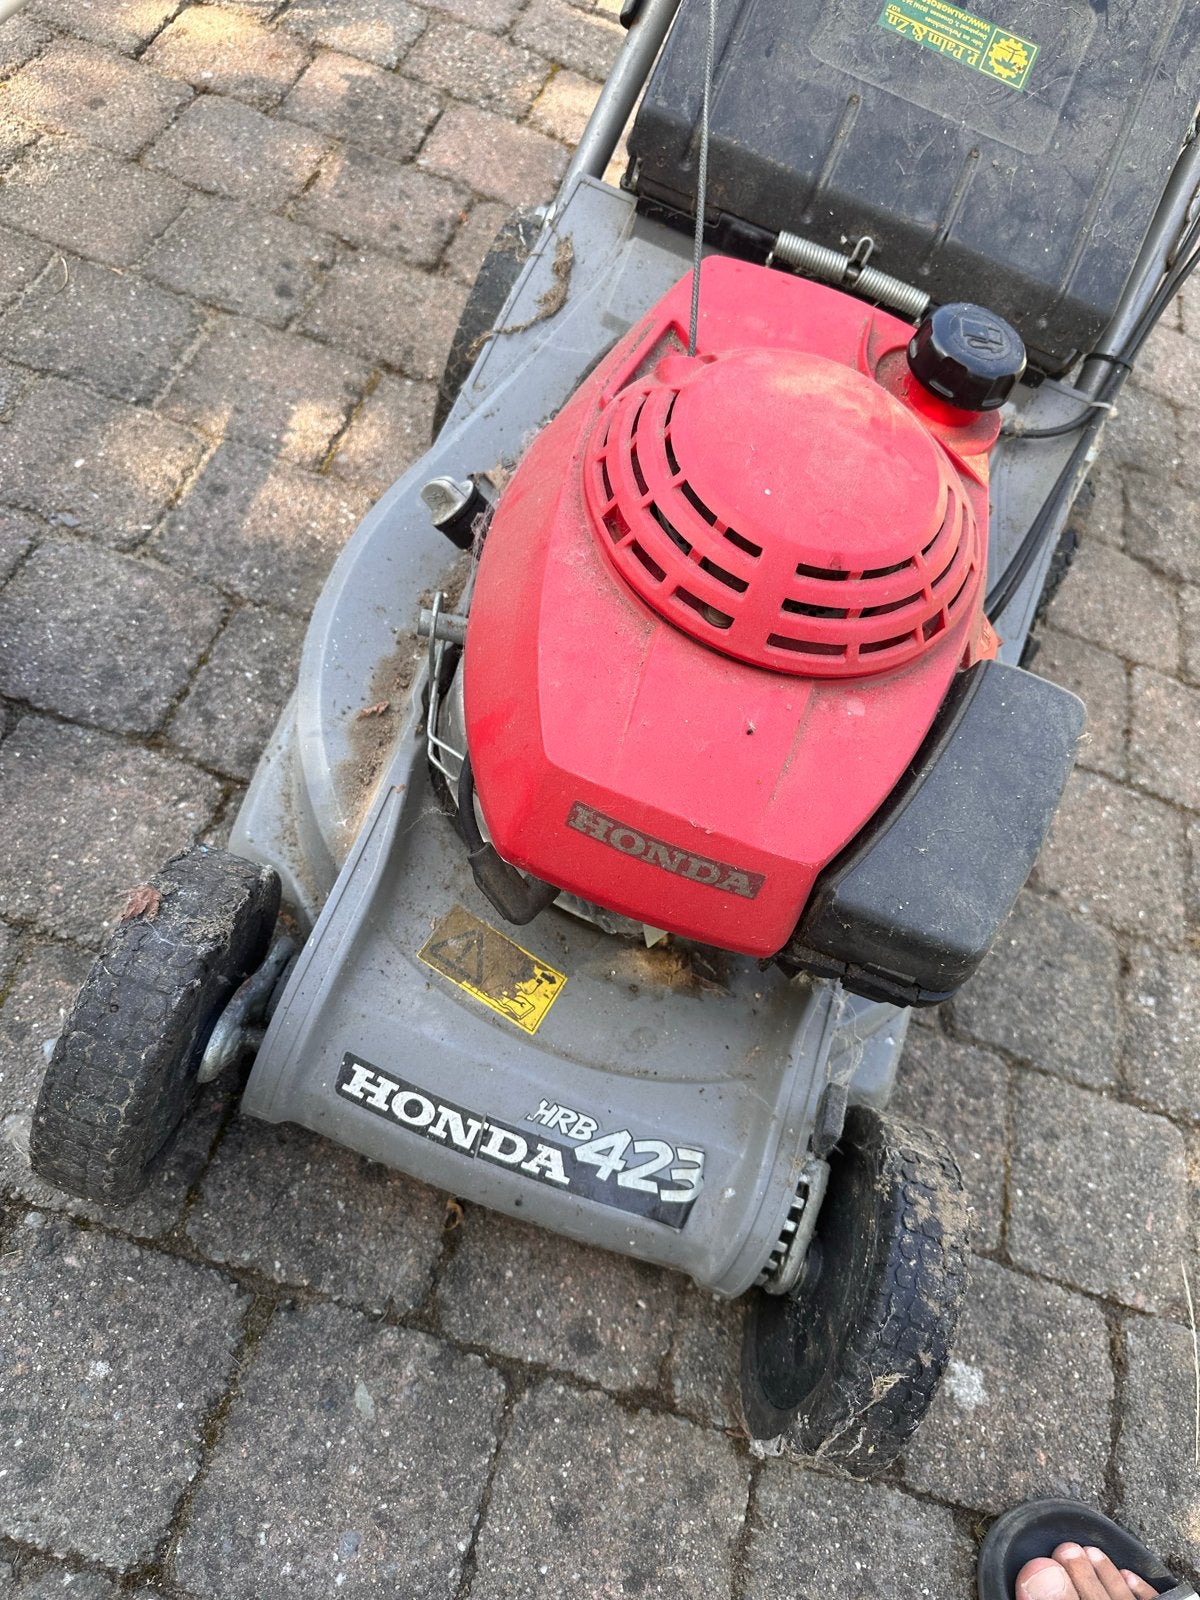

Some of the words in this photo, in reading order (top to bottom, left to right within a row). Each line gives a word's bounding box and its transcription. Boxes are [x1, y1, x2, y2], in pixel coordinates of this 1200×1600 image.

[885, 12, 909, 33] Zn.
[911, 23, 928, 41] &
[928, 32, 965, 60] Palm
[967, 51, 980, 66] P.
[568, 805, 757, 898] HONDA
[341, 1062, 571, 1185] HONDA
[525, 1098, 600, 1142] HRB
[574, 1129, 706, 1203] 423
